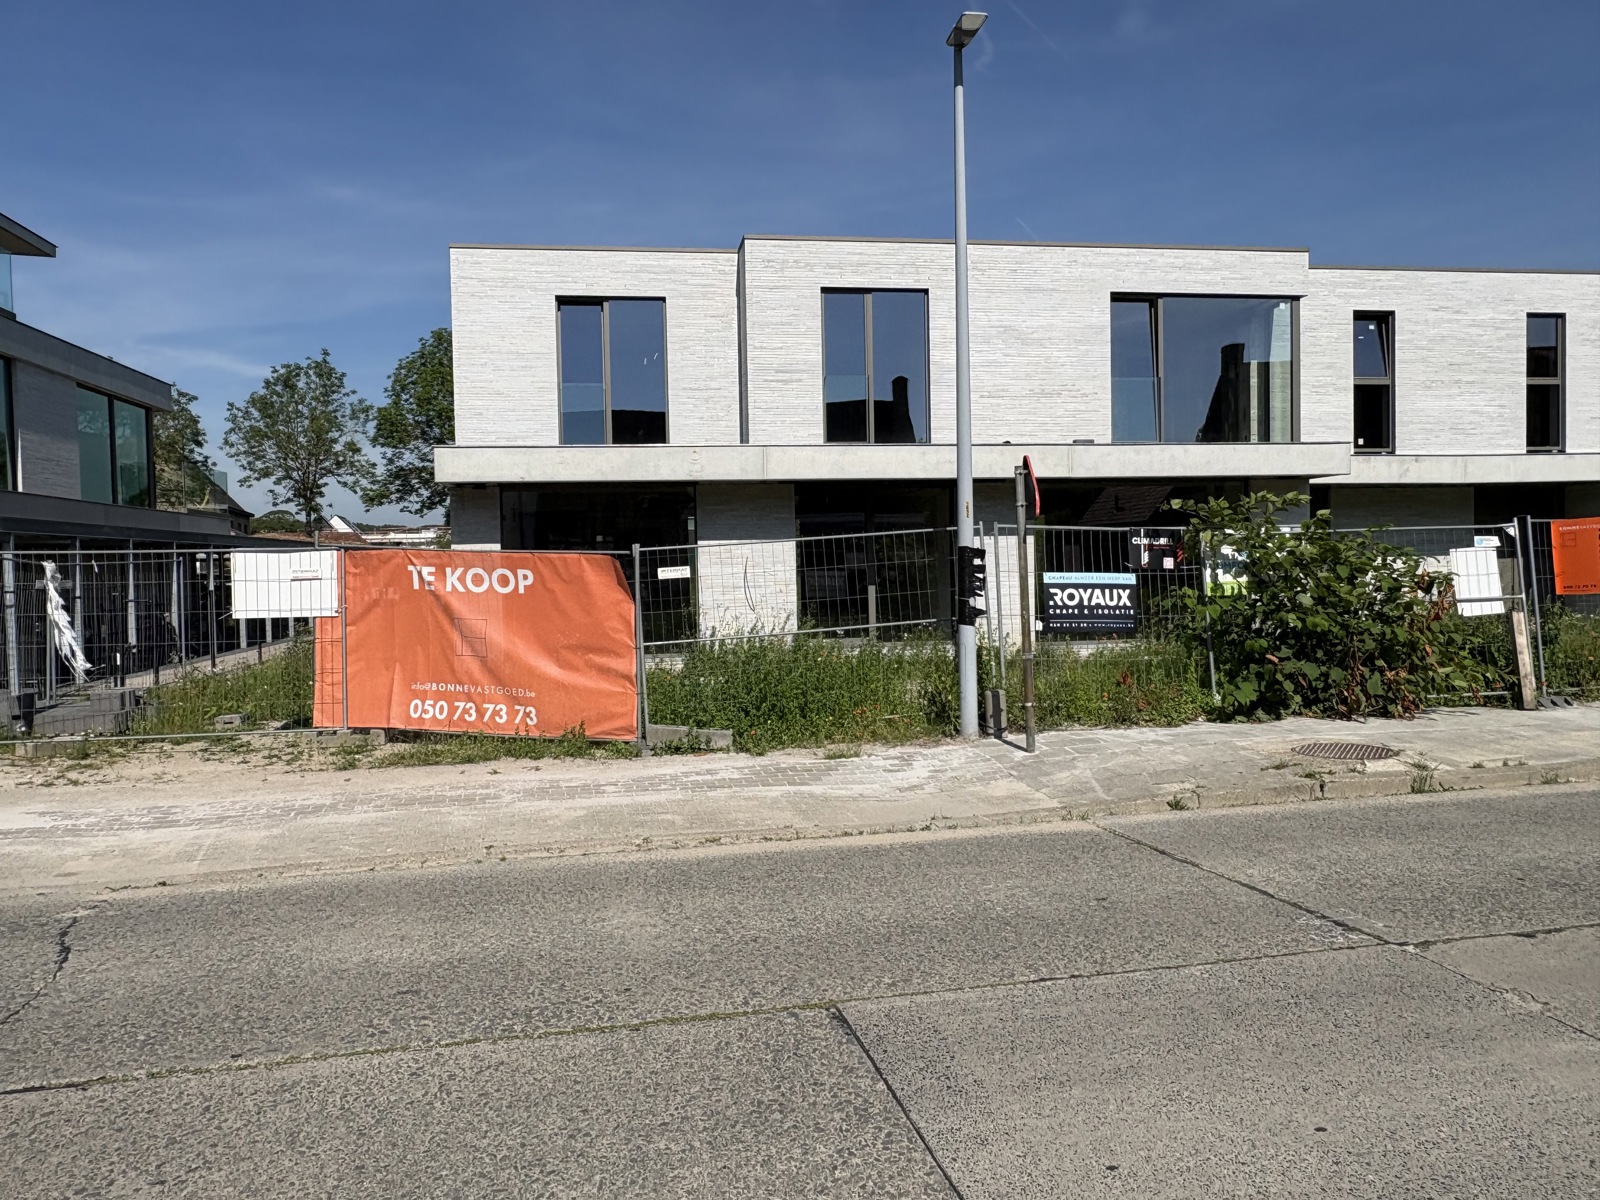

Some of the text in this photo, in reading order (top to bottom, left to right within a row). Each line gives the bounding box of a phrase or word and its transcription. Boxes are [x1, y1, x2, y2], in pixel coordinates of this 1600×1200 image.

[407, 565, 534, 594] TE KOOP
[1048, 588, 1132, 606] ROYAUX
[409, 699, 538, 726] 050 73 73 73
